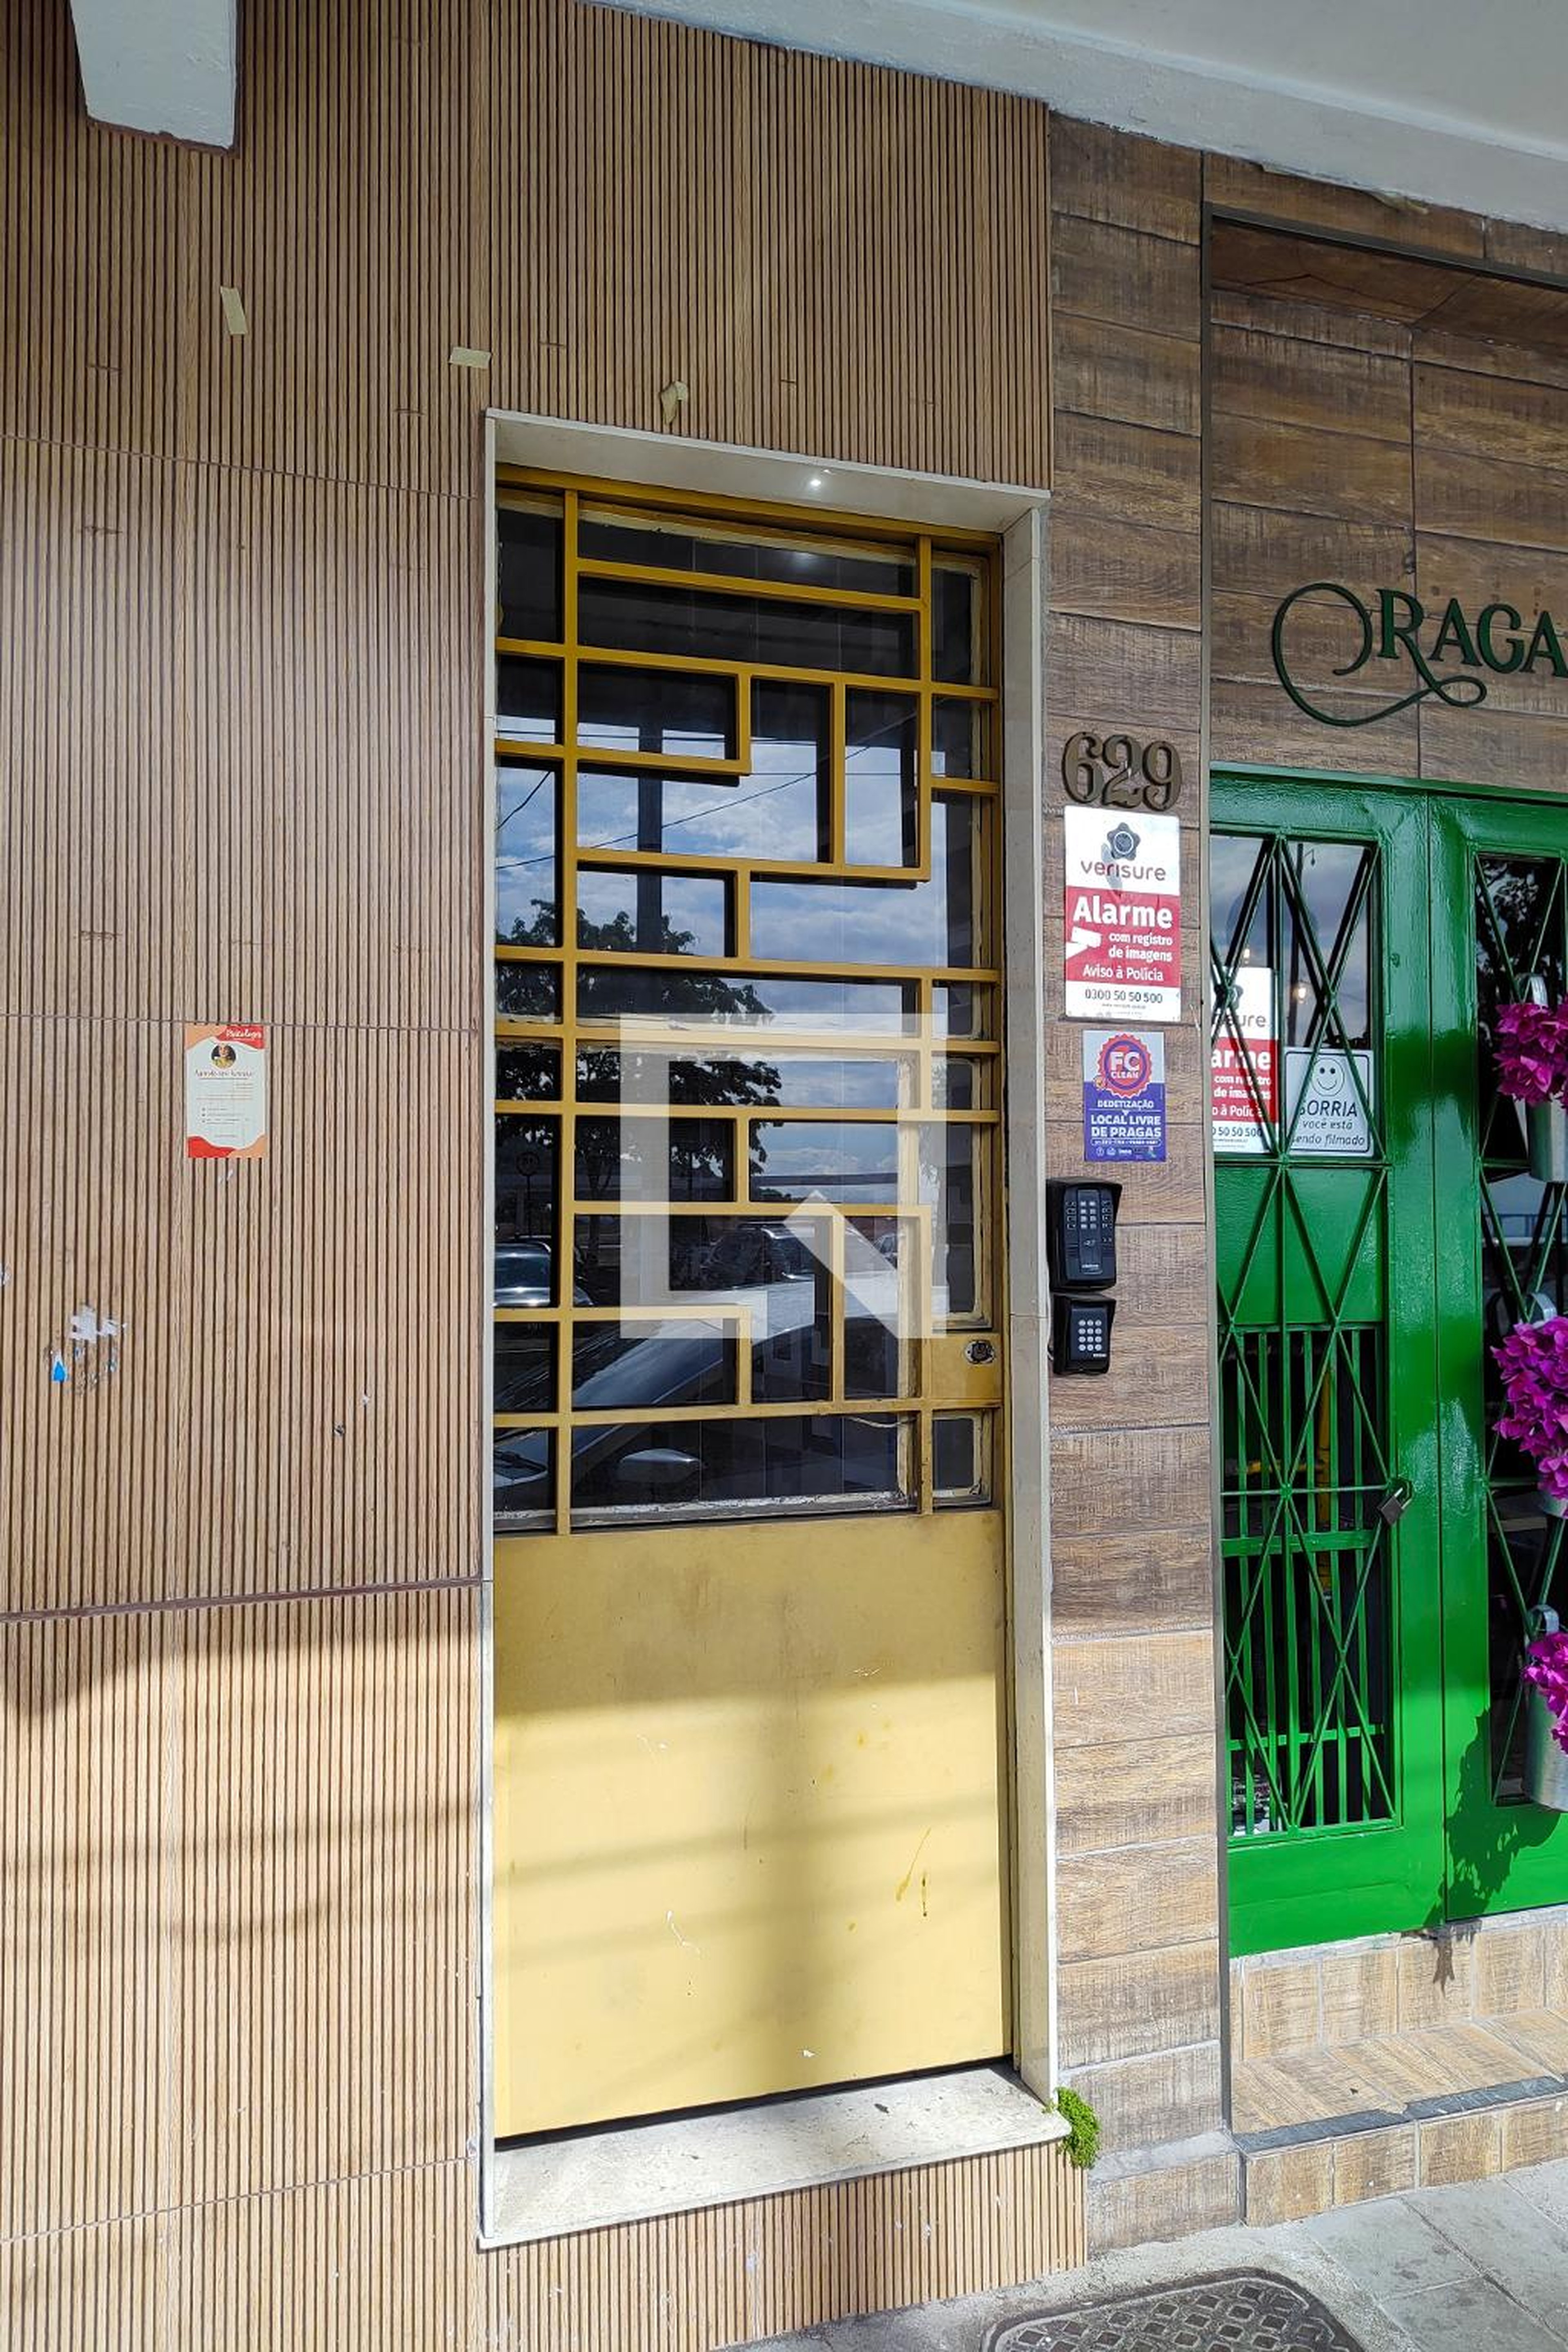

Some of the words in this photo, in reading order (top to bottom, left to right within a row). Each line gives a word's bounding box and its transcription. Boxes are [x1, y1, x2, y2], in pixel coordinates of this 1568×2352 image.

[1062, 731, 1182, 812] 629
[1080, 860, 1166, 881] verisure
[1073, 895, 1173, 929] Alarme
[1108, 932, 1131, 943] com
[1133, 932, 1173, 947] registro
[1108, 945, 1123, 958] de
[1125, 945, 1173, 962] imagens
[1083, 964, 1113, 978] Aviso
[1116, 966, 1123, 978] à
[1126, 967, 1163, 981] Polícia
[1085, 988, 1111, 1000] 0300
[1114, 990, 1126, 1000] 50
[1128, 991, 1141, 1002] 50
[1143, 992, 1163, 1003] 500
[1110, 1052, 1140, 1071] FC
[1214, 1086, 1227, 1097] de
[1097, 1099, 1154, 1110] DEDETIZAÇÃO
[1091, 1114, 1127, 1125] LOCAL
[1129, 1116, 1161, 1125] LIVRE
[1303, 1118, 1327, 1129] você
[1091, 1126, 1107, 1137] DE
[1110, 1127, 1161, 1137] PRAGAS
[1218, 1127, 1230, 1136] 50
[1232, 1127, 1243, 1136] 50
[1324, 1134, 1365, 1147] filmado
